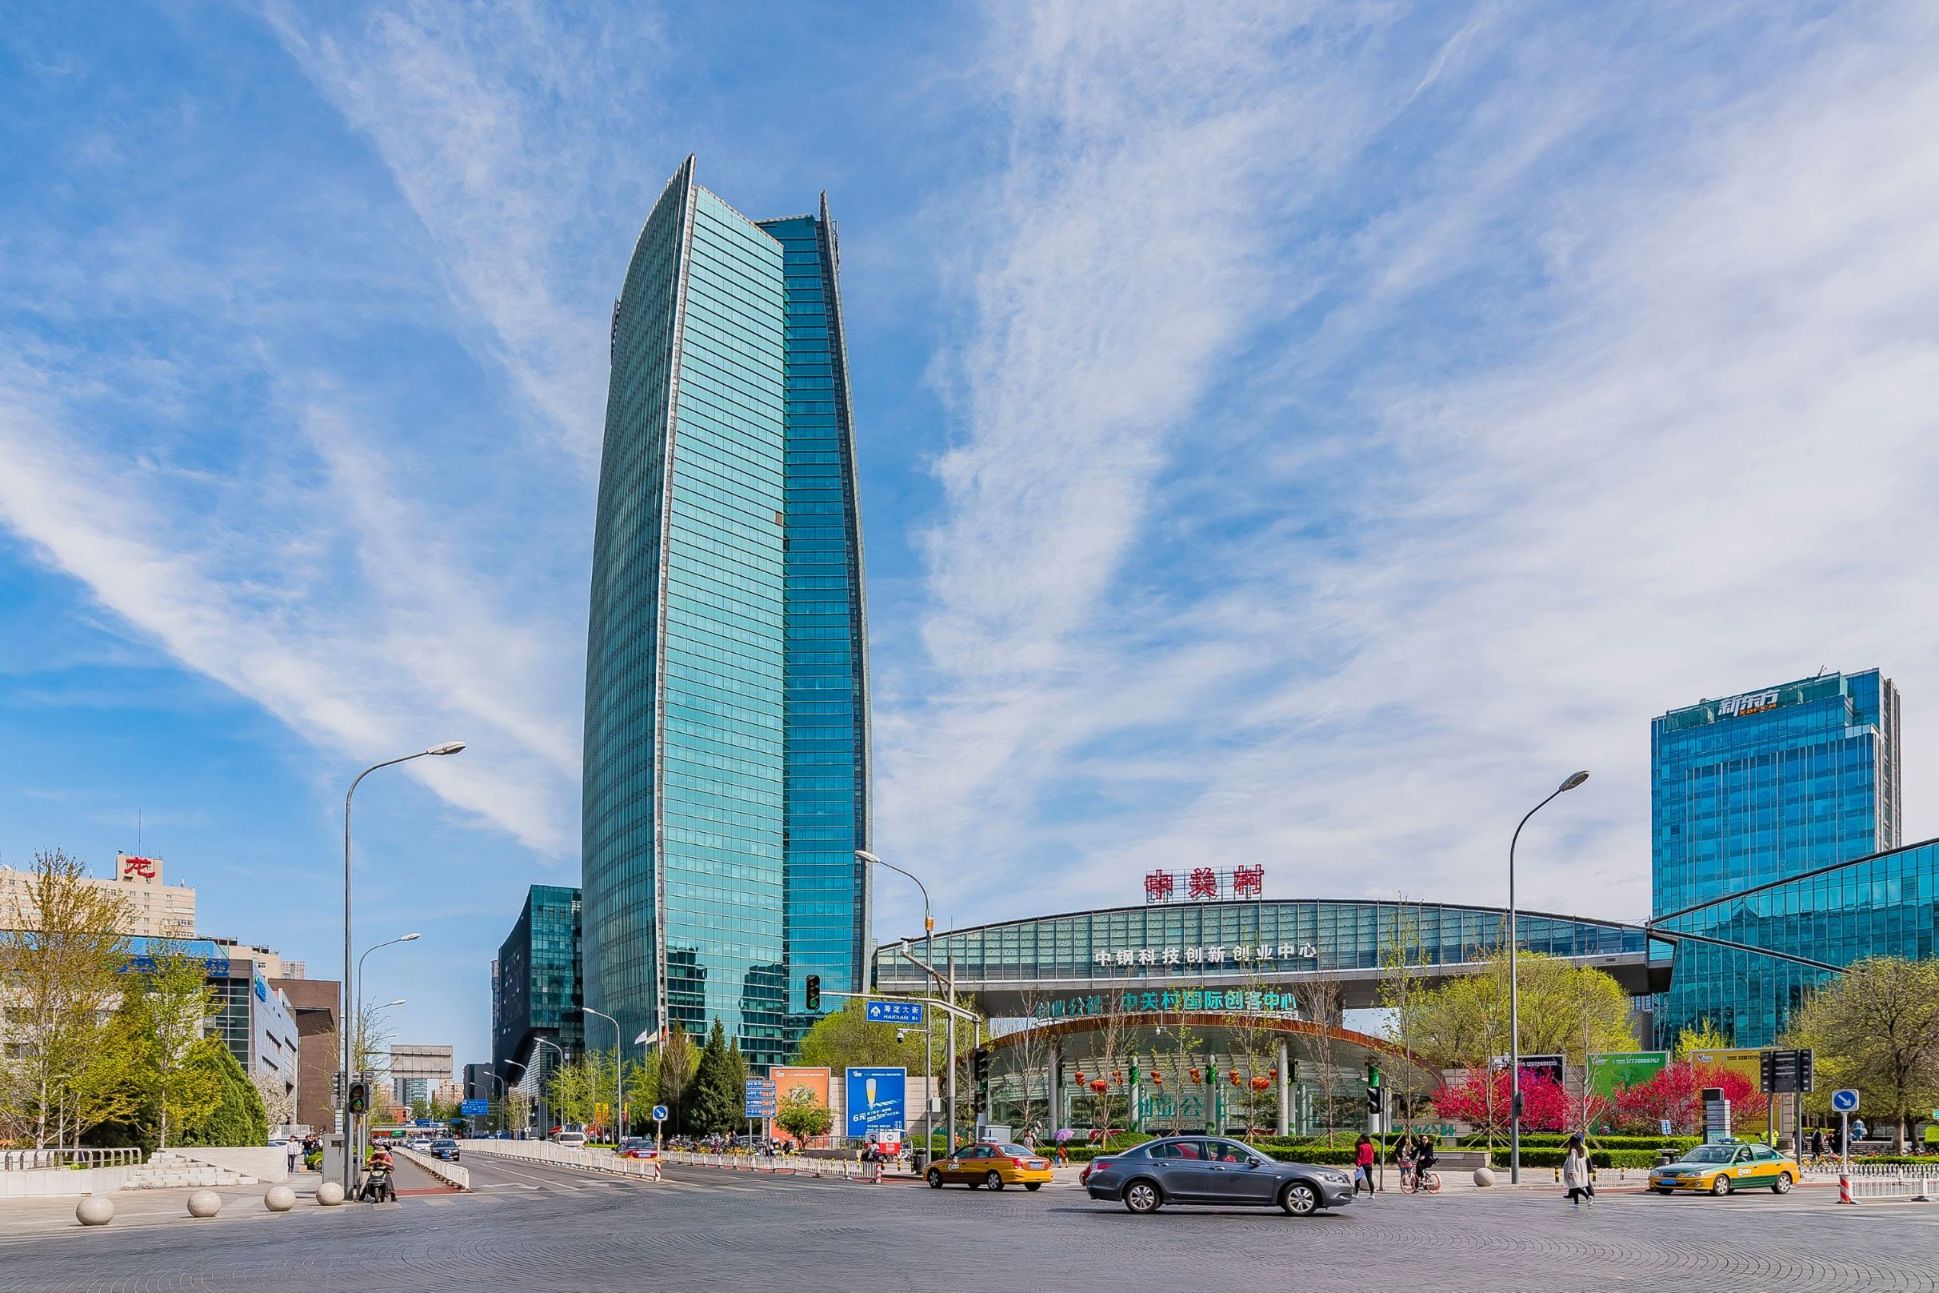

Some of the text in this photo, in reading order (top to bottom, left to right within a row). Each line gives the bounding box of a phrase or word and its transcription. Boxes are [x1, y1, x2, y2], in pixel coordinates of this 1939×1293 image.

[1718, 690, 1779, 716] 新东方
[1095, 943, 1318, 966] 中钢科技创新创业中心
[883, 1005, 919, 1014] 海淀大街
[1121, 991, 1297, 1011] 中关村国际创客中心
